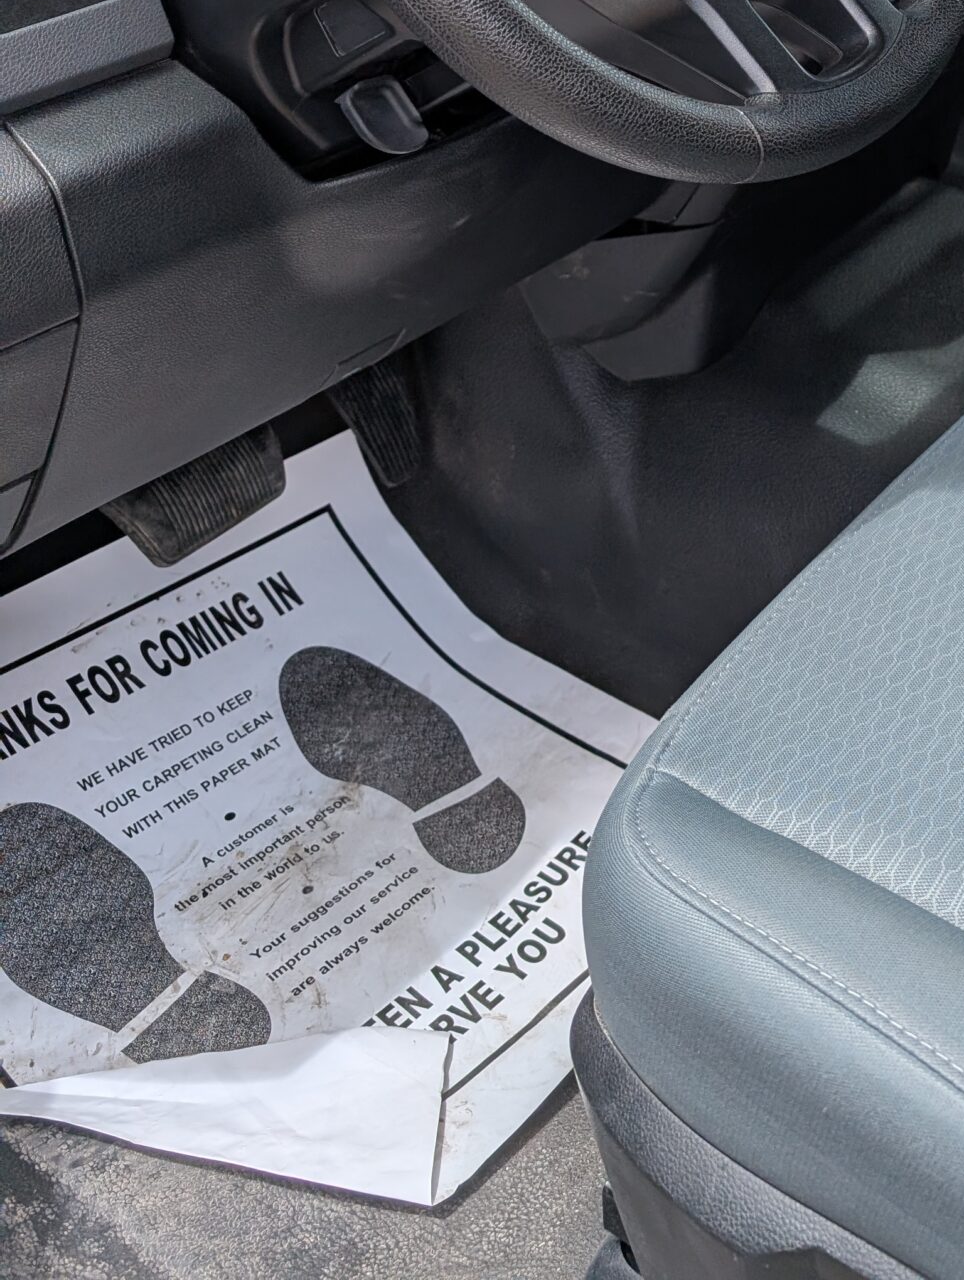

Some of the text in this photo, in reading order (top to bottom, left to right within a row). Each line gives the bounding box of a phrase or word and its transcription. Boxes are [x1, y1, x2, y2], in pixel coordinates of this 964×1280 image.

[0, 571, 304, 760] NKS FOR COMING IN
[77, 689, 254, 792] WE HAVE TRIED TO KEEP
[94, 710, 274, 818] YOUR CARPETING CLEAN
[122, 736, 282, 839] WITH THIS PAPER MAT
[174, 796, 350, 912] the most important person
[201, 804, 294, 868] A customer is
[218, 830, 345, 910] in the world to us.
[249, 853, 396, 960] Your suggestions for
[265, 865, 419, 982] improving our service
[291, 886, 436, 997] are always welcome.
[430, 965, 465, 994] A
[455, 830, 592, 968] PLEASURE
[494, 917, 566, 980] YOU
